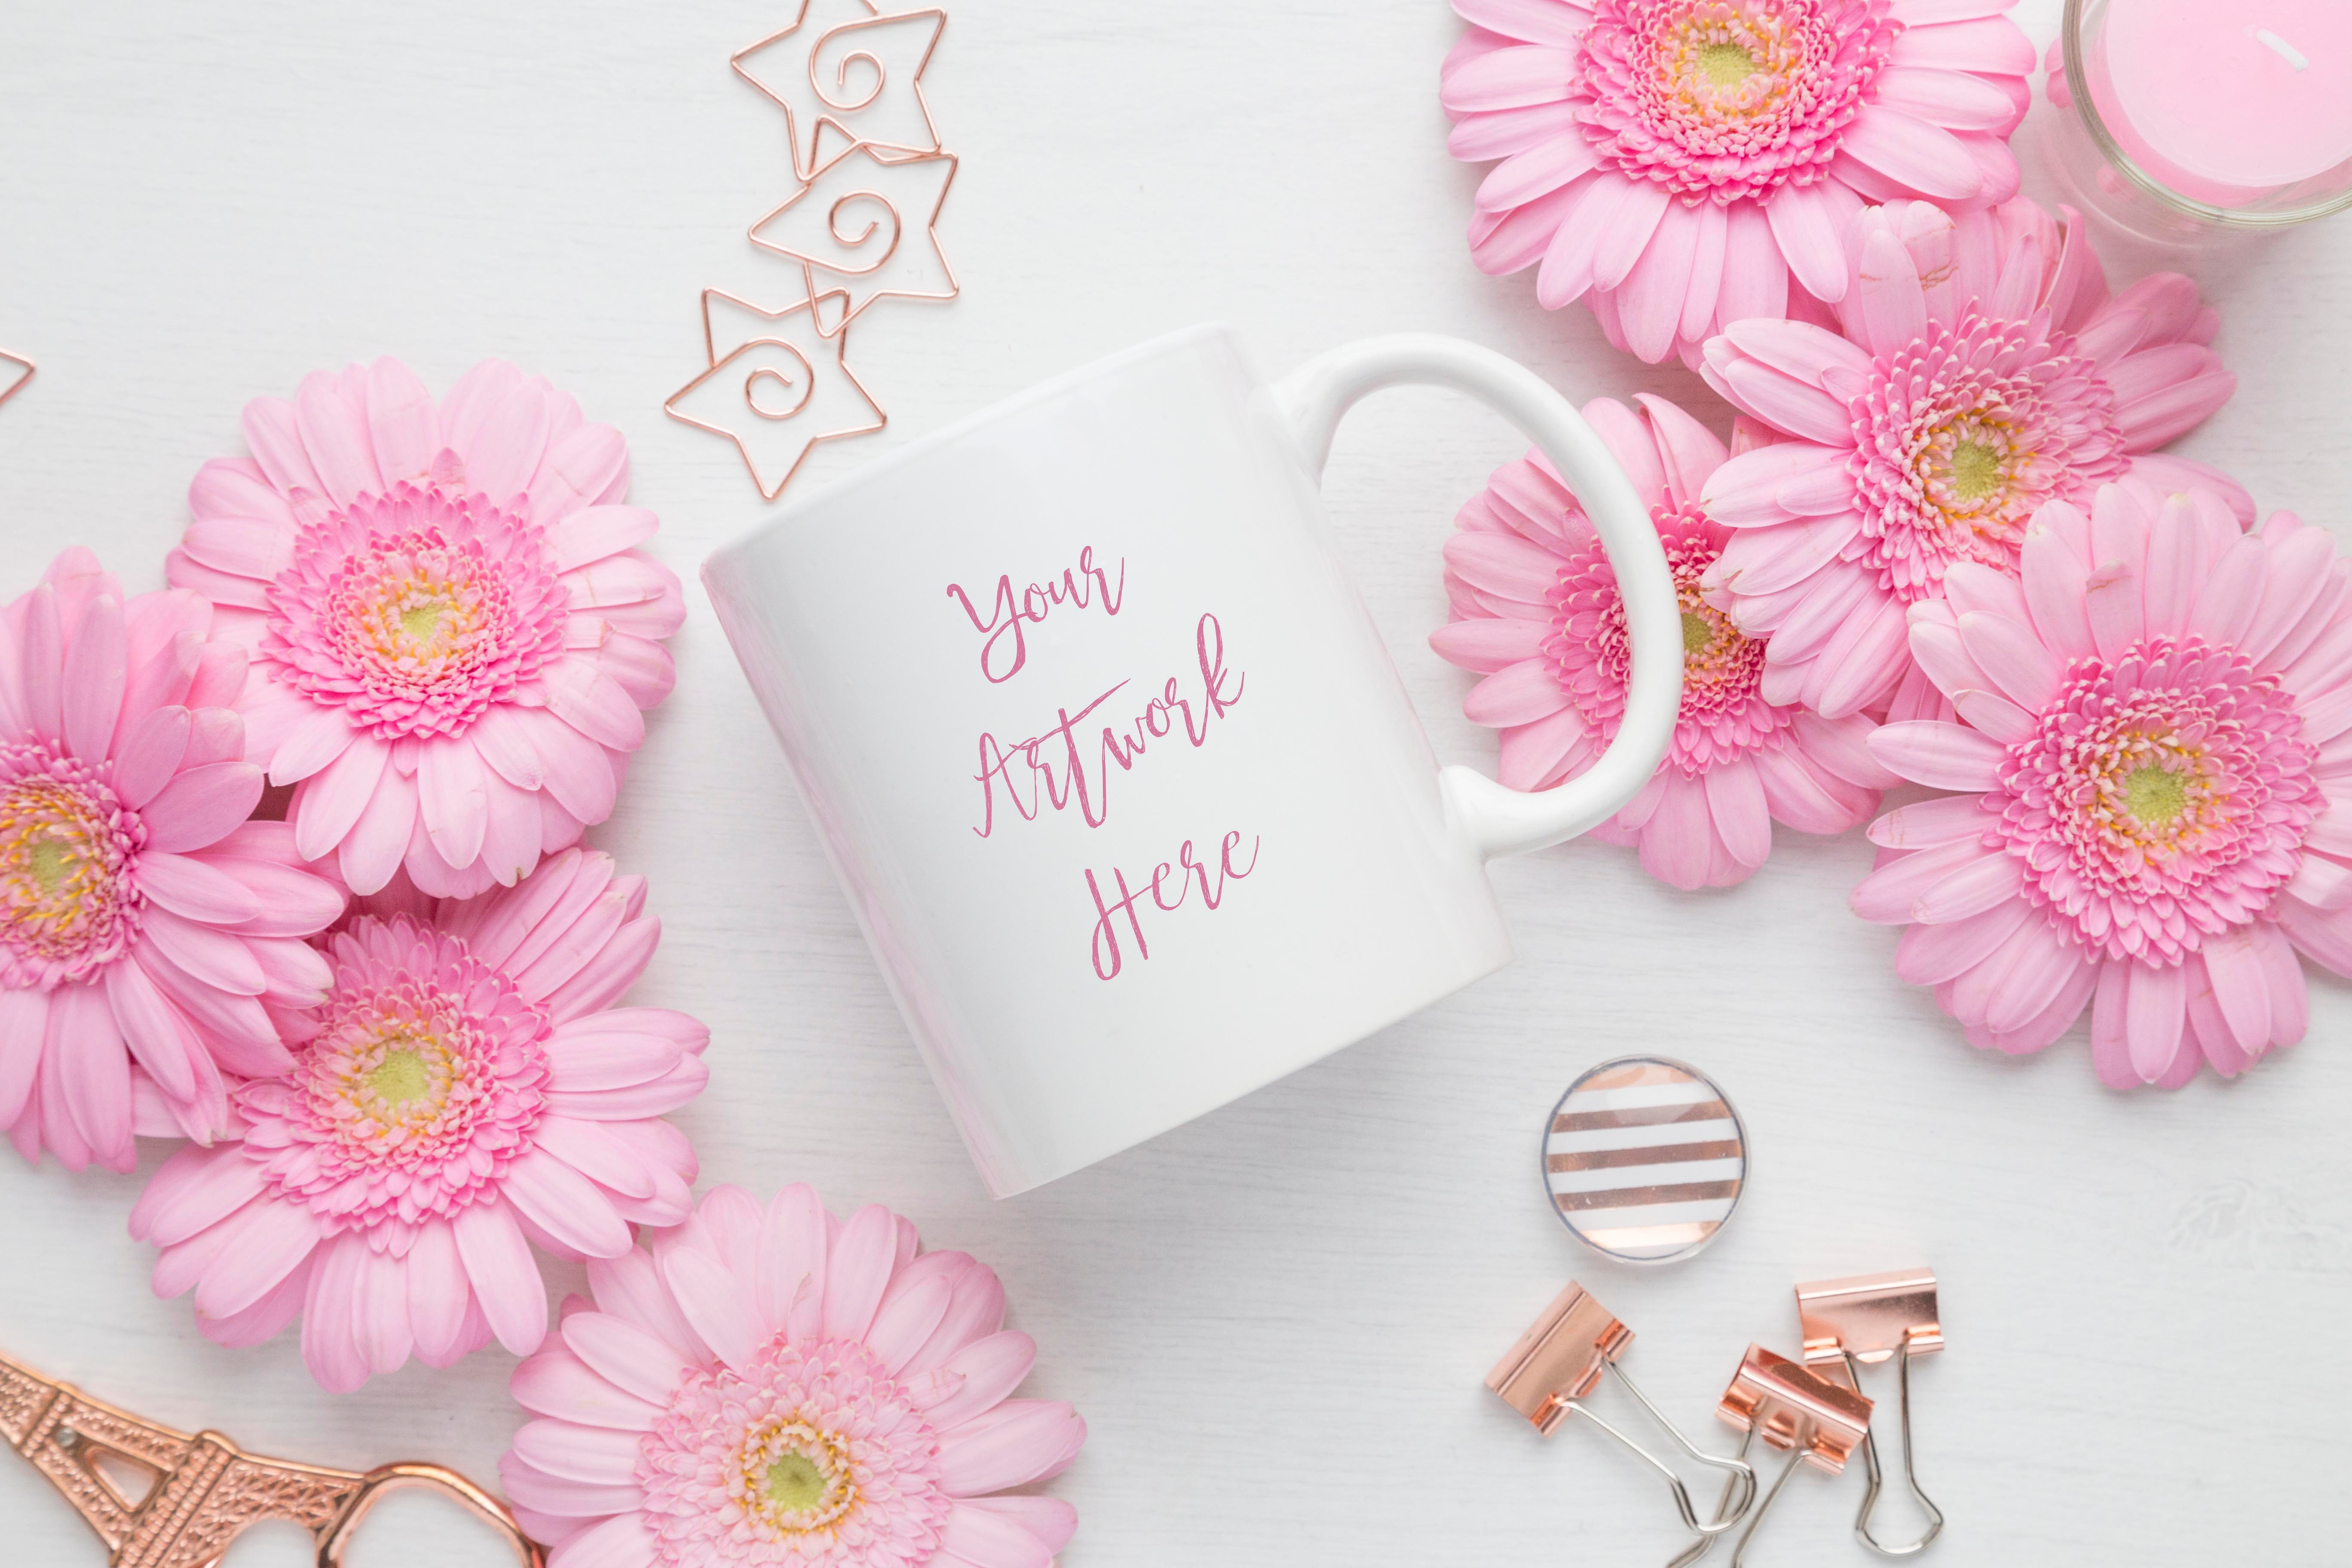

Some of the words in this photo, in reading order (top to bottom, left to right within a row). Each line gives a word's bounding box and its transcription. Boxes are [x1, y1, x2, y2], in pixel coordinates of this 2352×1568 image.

[946, 545, 1124, 683] Your
[972, 613, 1245, 838] Artwork
[1084, 831, 1259, 981] Here
